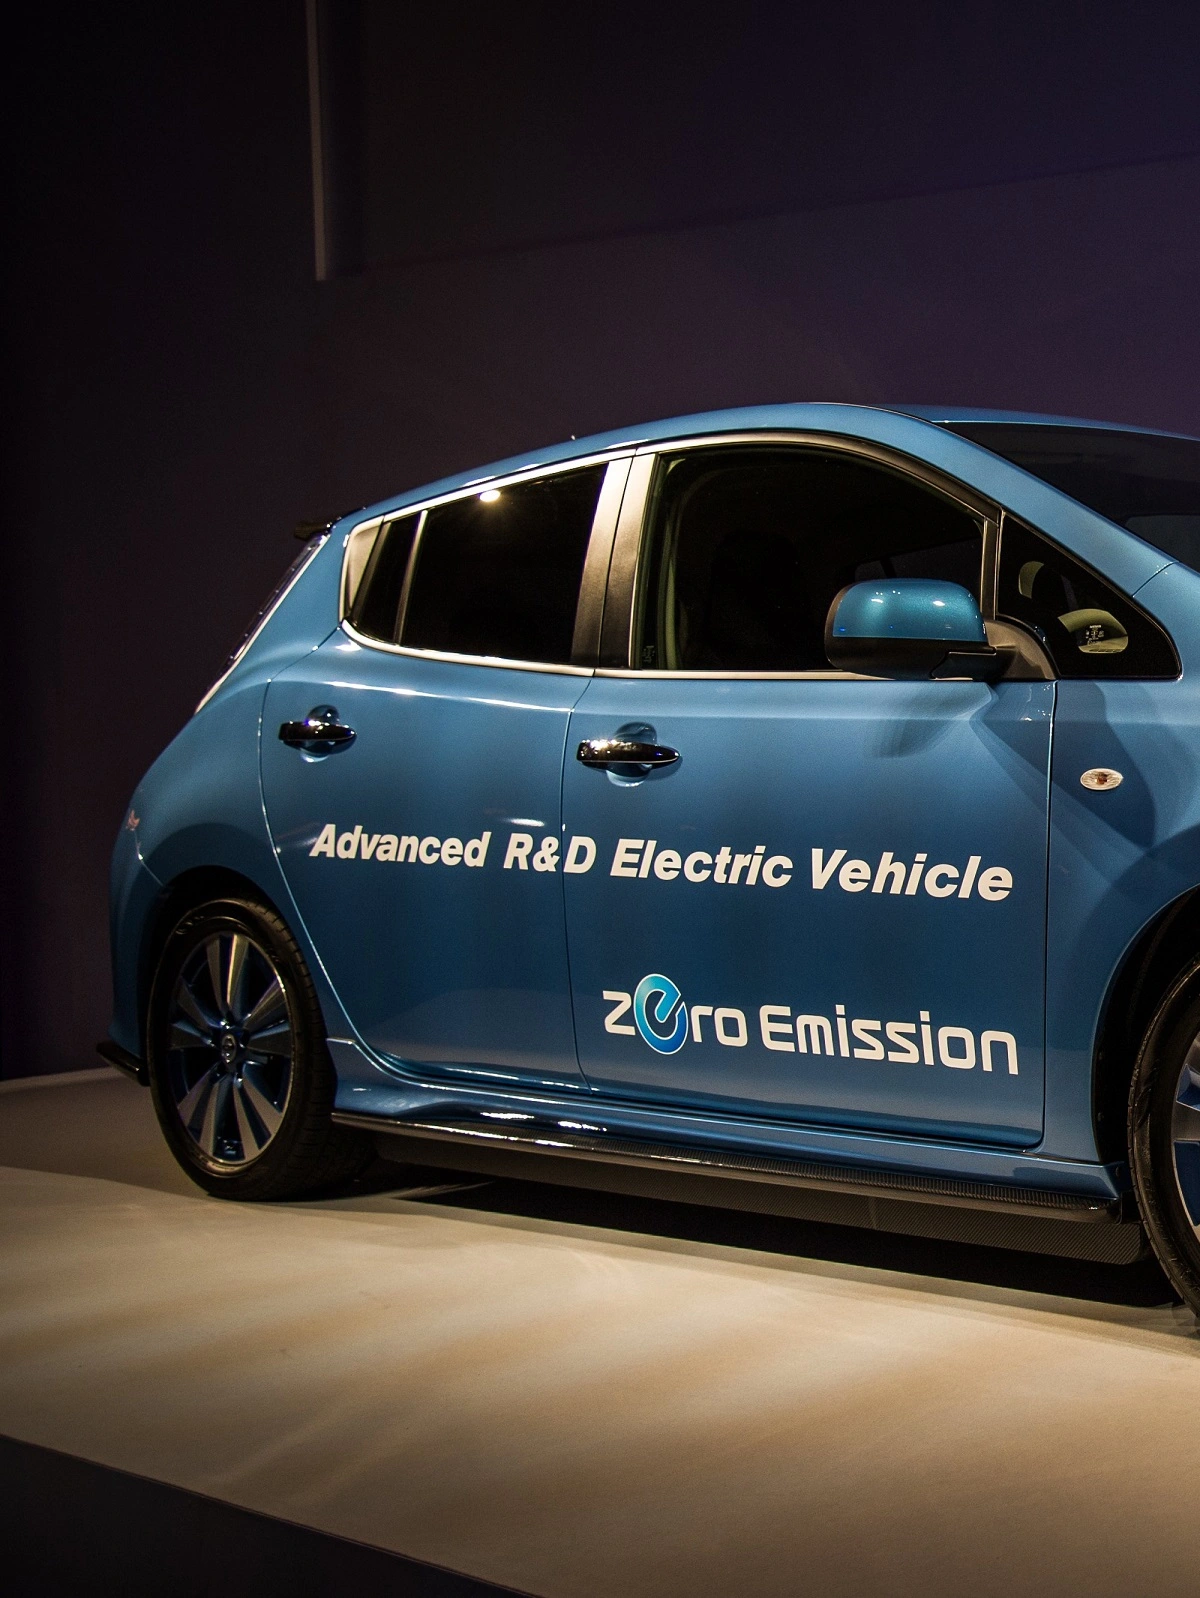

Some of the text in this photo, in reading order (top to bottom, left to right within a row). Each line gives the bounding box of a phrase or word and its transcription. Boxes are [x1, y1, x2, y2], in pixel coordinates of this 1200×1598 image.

[309, 823, 1014, 902] Advanced R&D Electric Vehicle
[758, 1003, 1019, 1076] Emission
